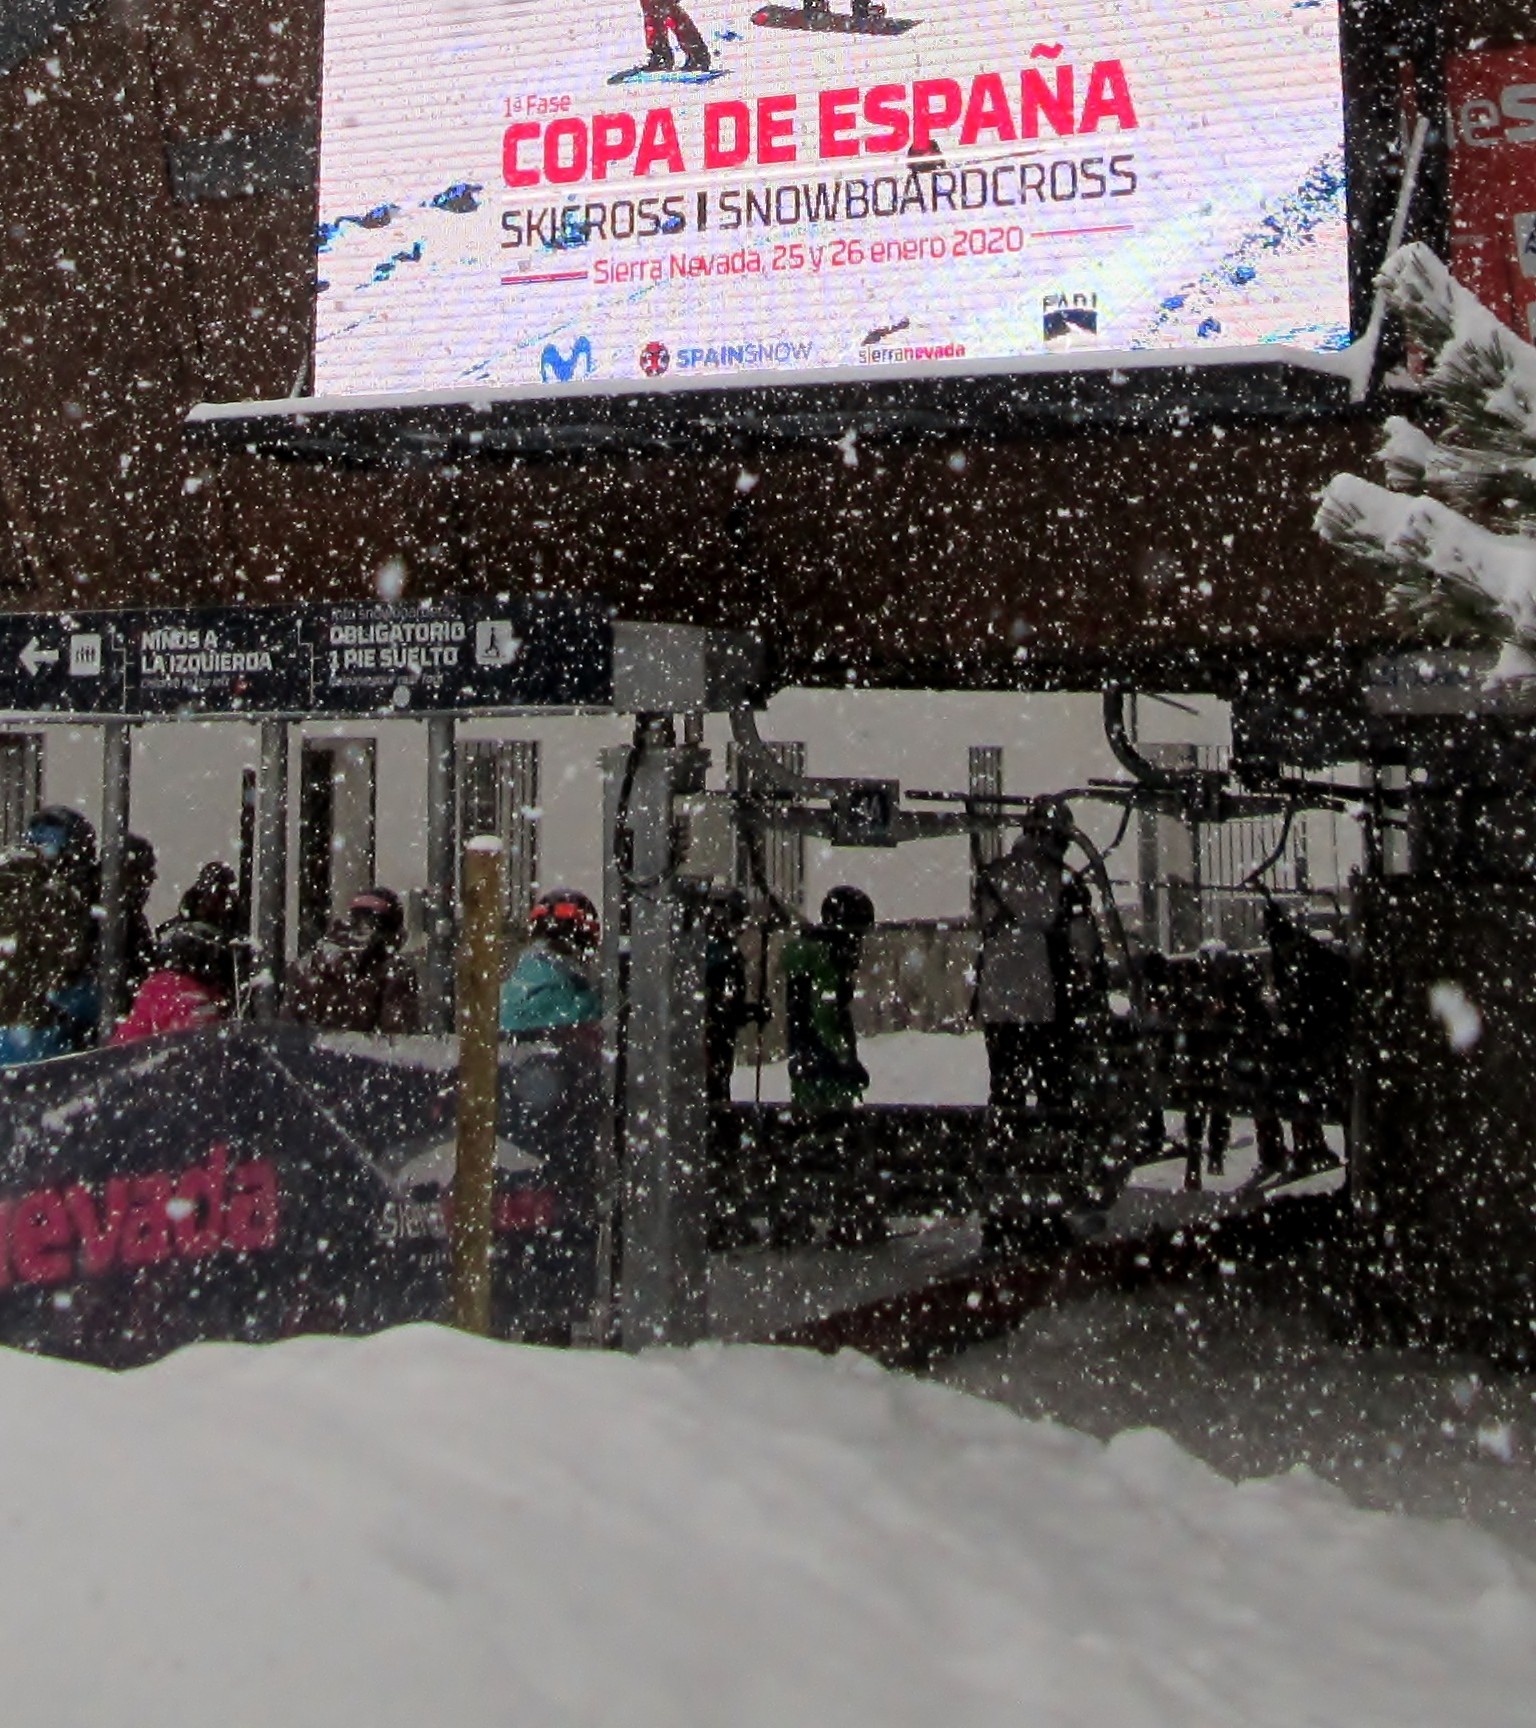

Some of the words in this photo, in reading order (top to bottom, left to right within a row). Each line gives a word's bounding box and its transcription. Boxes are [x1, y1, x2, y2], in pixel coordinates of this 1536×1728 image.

[502, 107, 686, 188] COPA
[704, 94, 797, 170] DE
[818, 42, 1139, 158] ESPAÑA
[526, 93, 571, 114] Fase
[718, 154, 1138, 230] SNOWBOARDCROSS
[593, 257, 663, 284] Sierra
[772, 243, 805, 270] 25
[809, 244, 824, 273] y
[831, 238, 865, 267] 26
[870, 235, 947, 263] enero
[953, 225, 1025, 257] 2020
[675, 340, 814, 369] SPAINSNOW
[204, 629, 218, 650] A
[330, 622, 466, 646] OBLIGATORIO
[142, 653, 165, 674] LA
[344, 648, 377, 670] PIE
[380, 646, 460, 669] SUELTO
